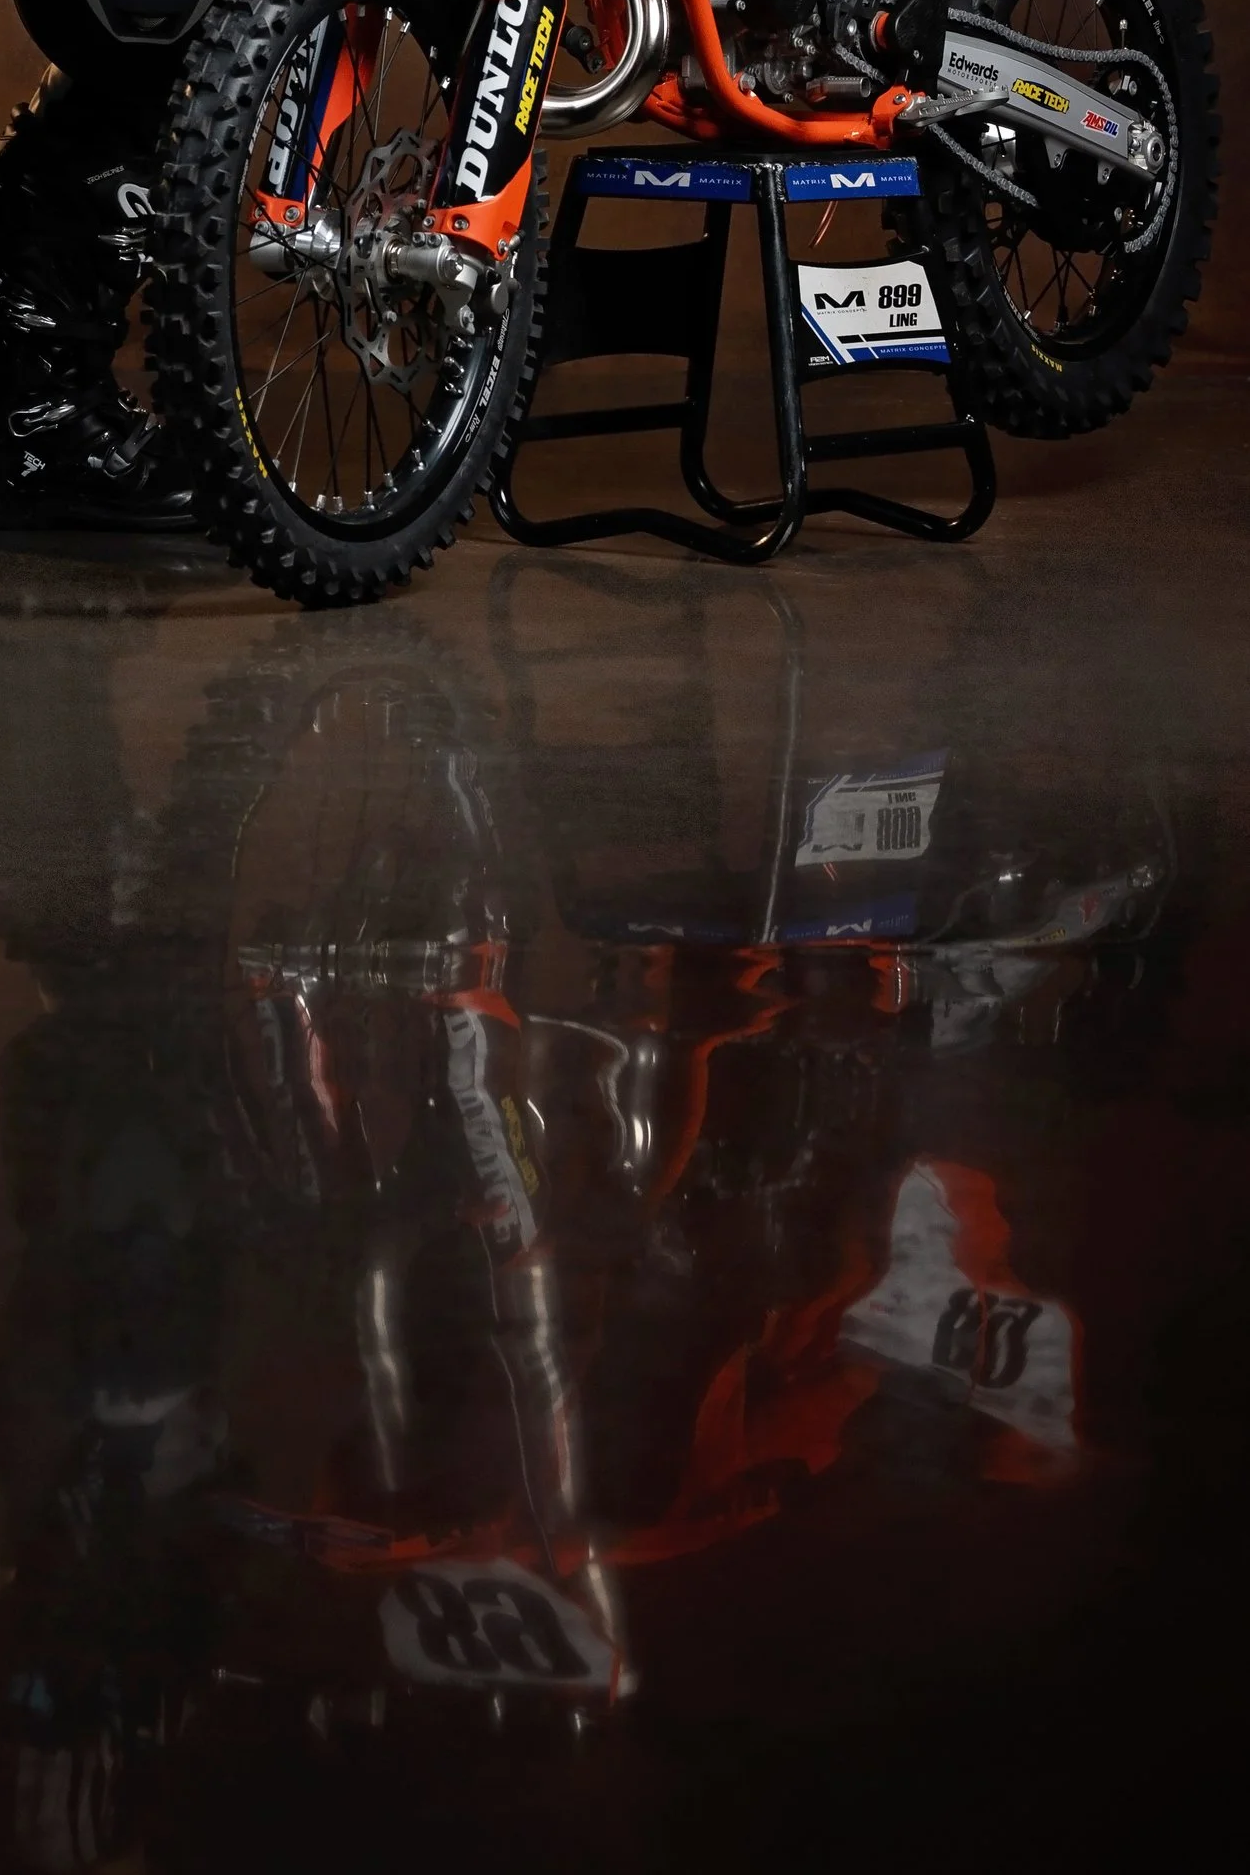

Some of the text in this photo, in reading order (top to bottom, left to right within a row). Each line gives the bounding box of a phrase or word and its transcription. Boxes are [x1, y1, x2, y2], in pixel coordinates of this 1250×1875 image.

[515, 5, 555, 137] RACE TECH
[949, 52, 999, 82] Edwards
[1011, 78, 1071, 114] RACE TECH
[1082, 111, 1119, 136] AMSOIL
[587, 172, 627, 180] MATRIX
[792, 178, 826, 186] MATRIX
[881, 174, 913, 182] MATRIX
[878, 283, 922, 310] 899
[889, 312, 918, 328] LING
[908, 344, 947, 352] CONCEPTS
[479, 355, 501, 408] EXCEL
[23, 450, 46, 470] TECH
